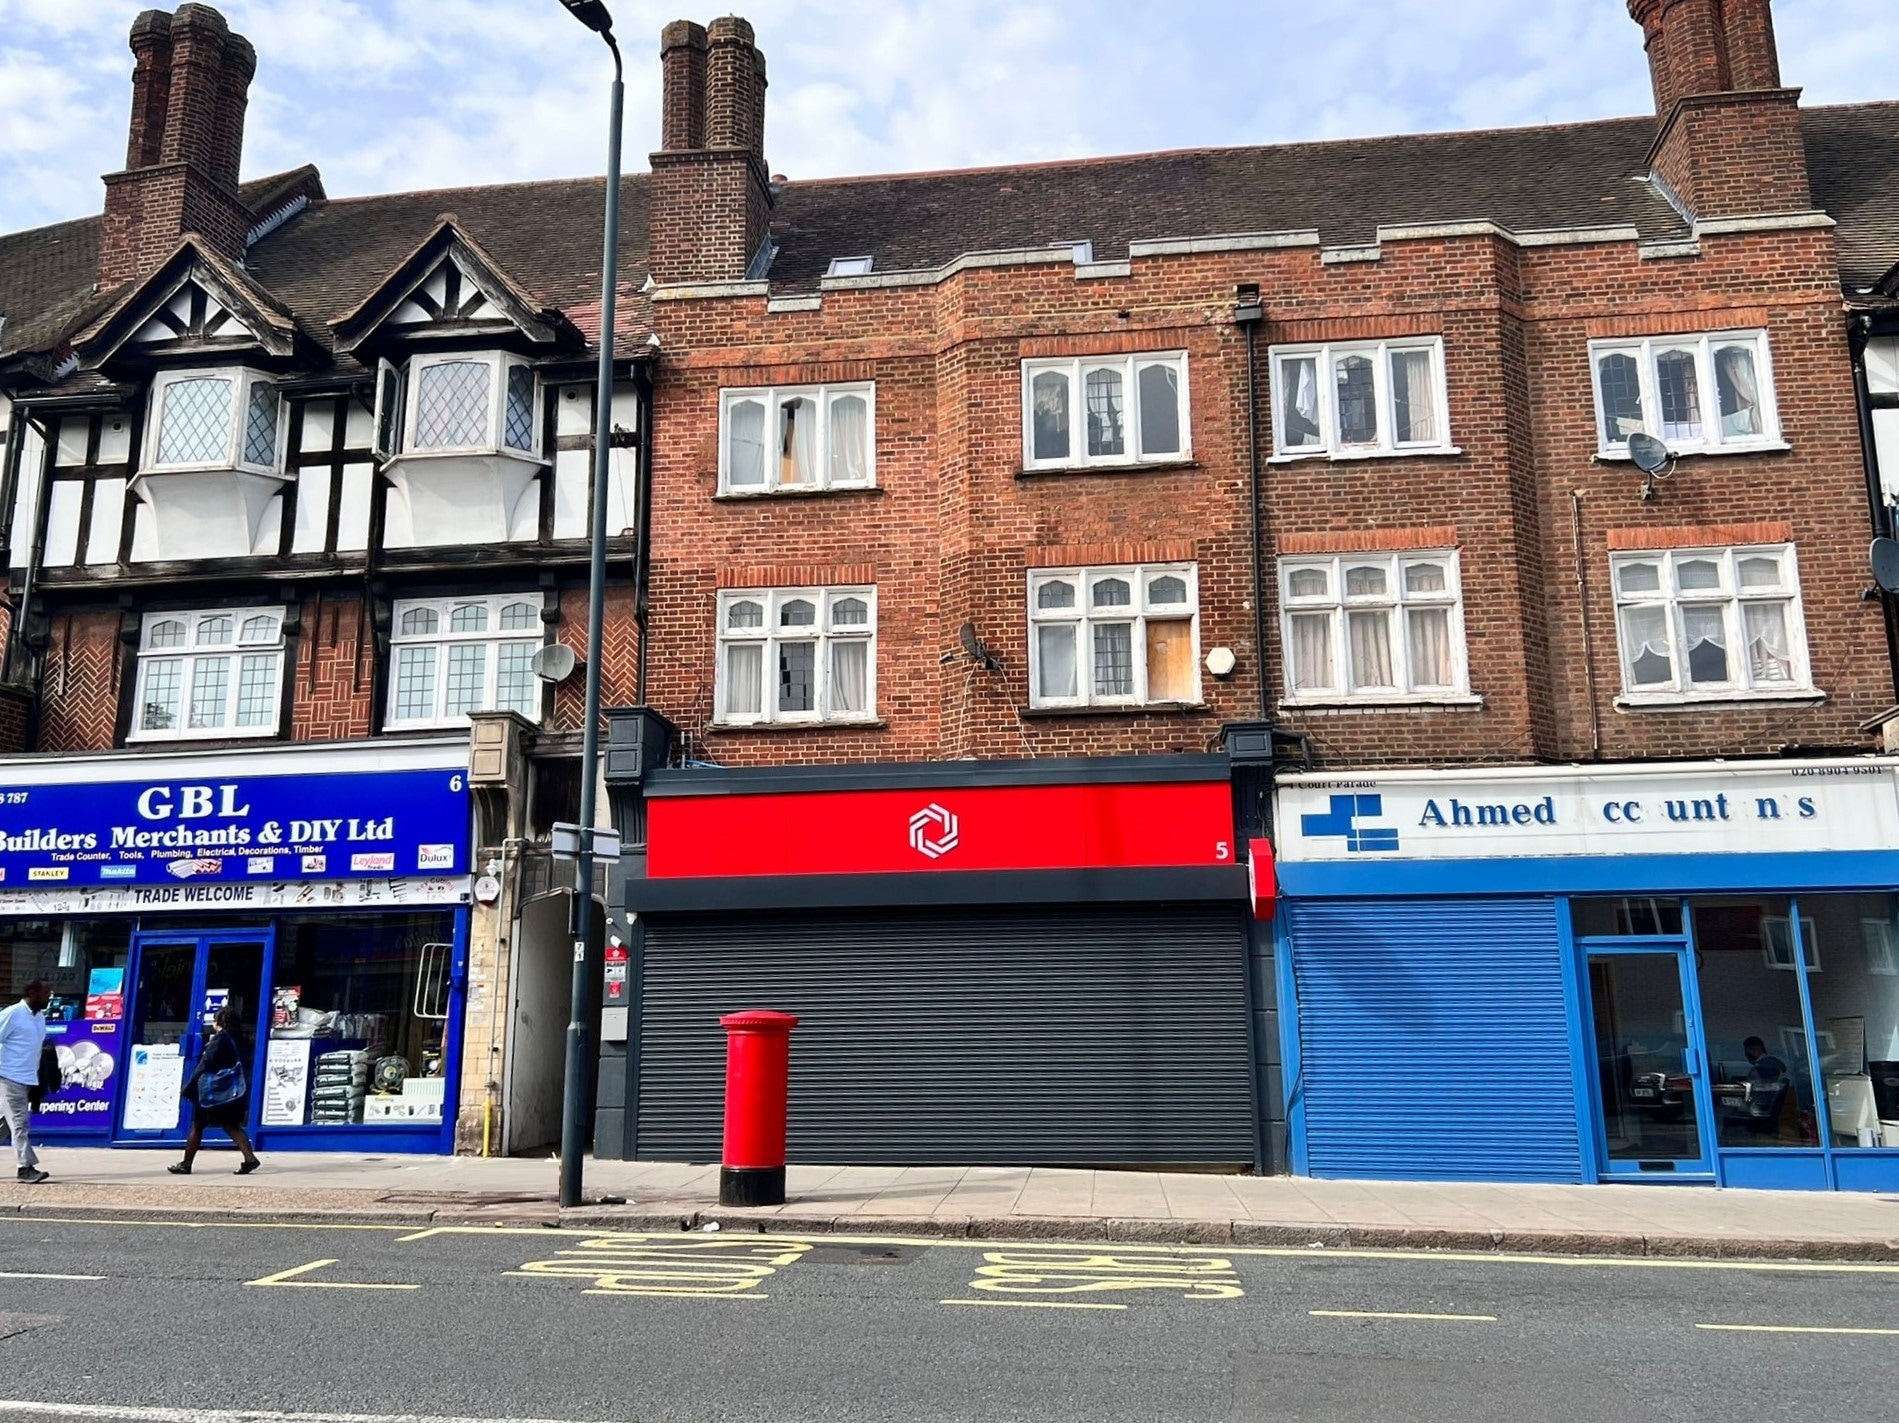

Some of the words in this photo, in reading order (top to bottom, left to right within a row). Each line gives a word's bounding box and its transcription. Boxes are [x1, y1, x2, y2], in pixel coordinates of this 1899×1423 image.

[450, 775, 462, 792] 6
[1336, 780, 1376, 788] Parade
[7, 792, 28, 804] 787
[138, 785, 250, 820] GBL
[1418, 796, 1557, 826] Ahmed
[110, 824, 250, 849] Merchants
[258, 821, 283, 844] &
[289, 819, 342, 843] DIY
[347, 817, 394, 841] Ltd
[51, 853, 74, 861] Trade
[76, 852, 111, 861] Counter,
[119, 850, 144, 860] Tools,
[151, 849, 193, 859] Plumbing,
[238, 845, 291, 856] Decorations,
[294, 844, 324, 854] Timber
[420, 853, 448, 863] Dulux
[1215, 842, 1228, 859] 5
[353, 856, 392, 867] Leyland
[33, 869, 65, 877] STANLEY
[134, 888, 180, 904] TRADE
[184, 885, 254, 903] WELCOME
[77, 1099, 110, 1112] Center
[969, 1251, 1244, 1299] BUS
